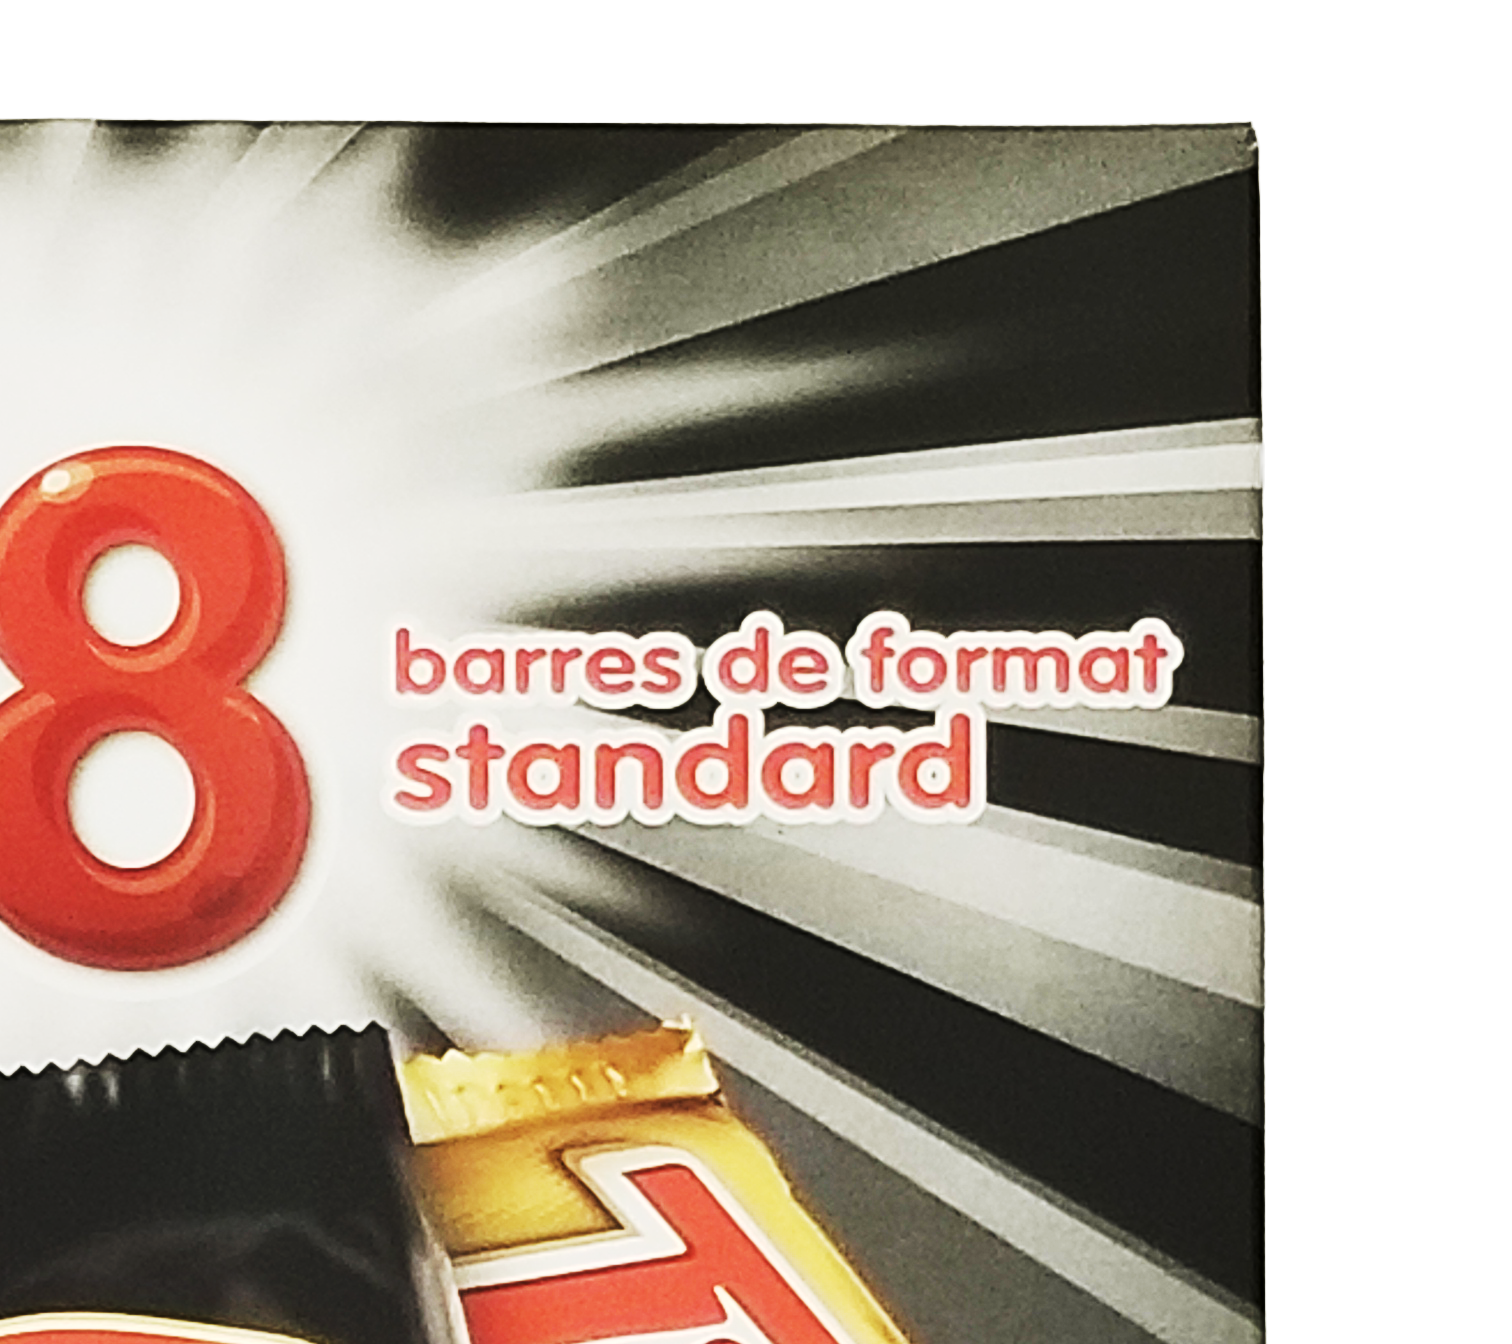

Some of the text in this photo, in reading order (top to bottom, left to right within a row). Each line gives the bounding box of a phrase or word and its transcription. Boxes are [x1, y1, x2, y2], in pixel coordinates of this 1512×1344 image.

[396, 625, 1169, 694] barres de format
[394, 712, 972, 812] standard
